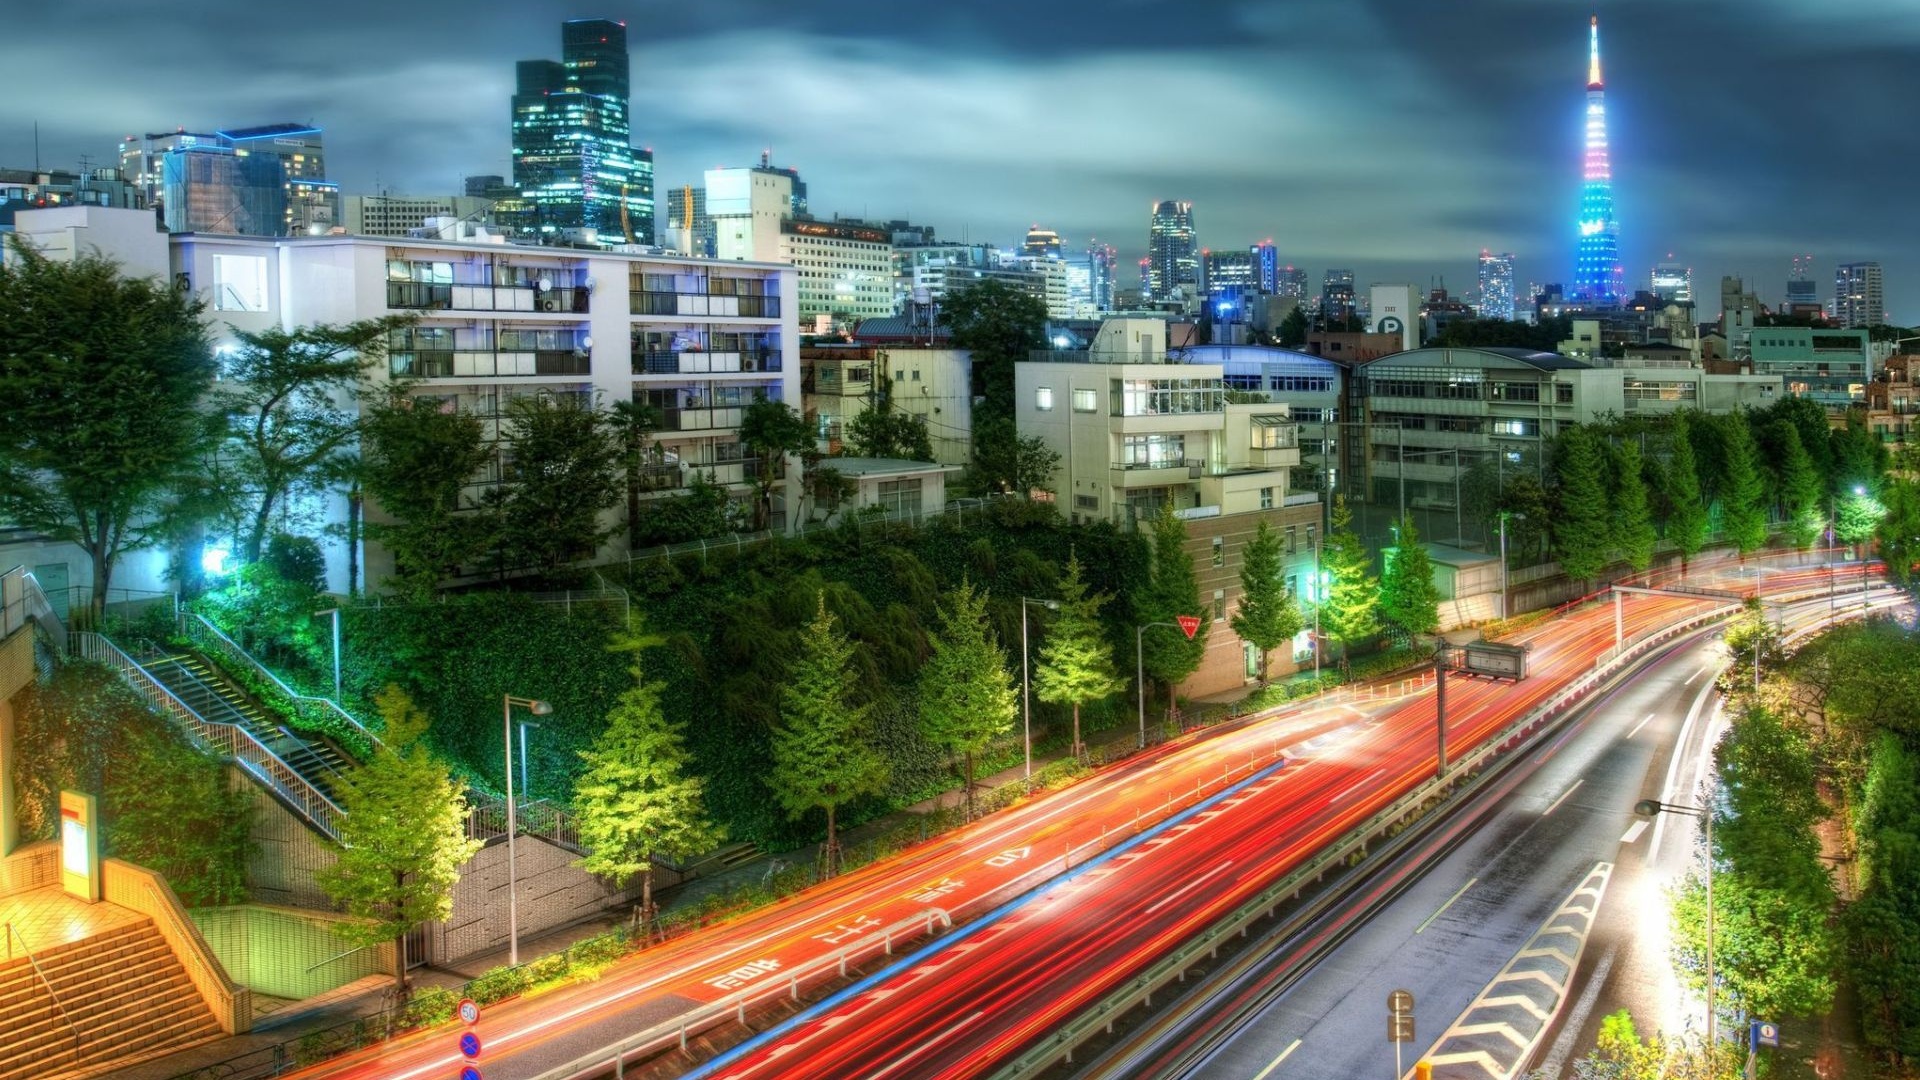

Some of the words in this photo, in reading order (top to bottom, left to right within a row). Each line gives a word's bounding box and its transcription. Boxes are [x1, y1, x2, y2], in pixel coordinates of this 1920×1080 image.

[175, 271, 190, 291] 25
[1384, 320, 1399, 334] P
[703, 846, 1032, 990] 合流注意
[462, 1005, 476, 1020] 50
